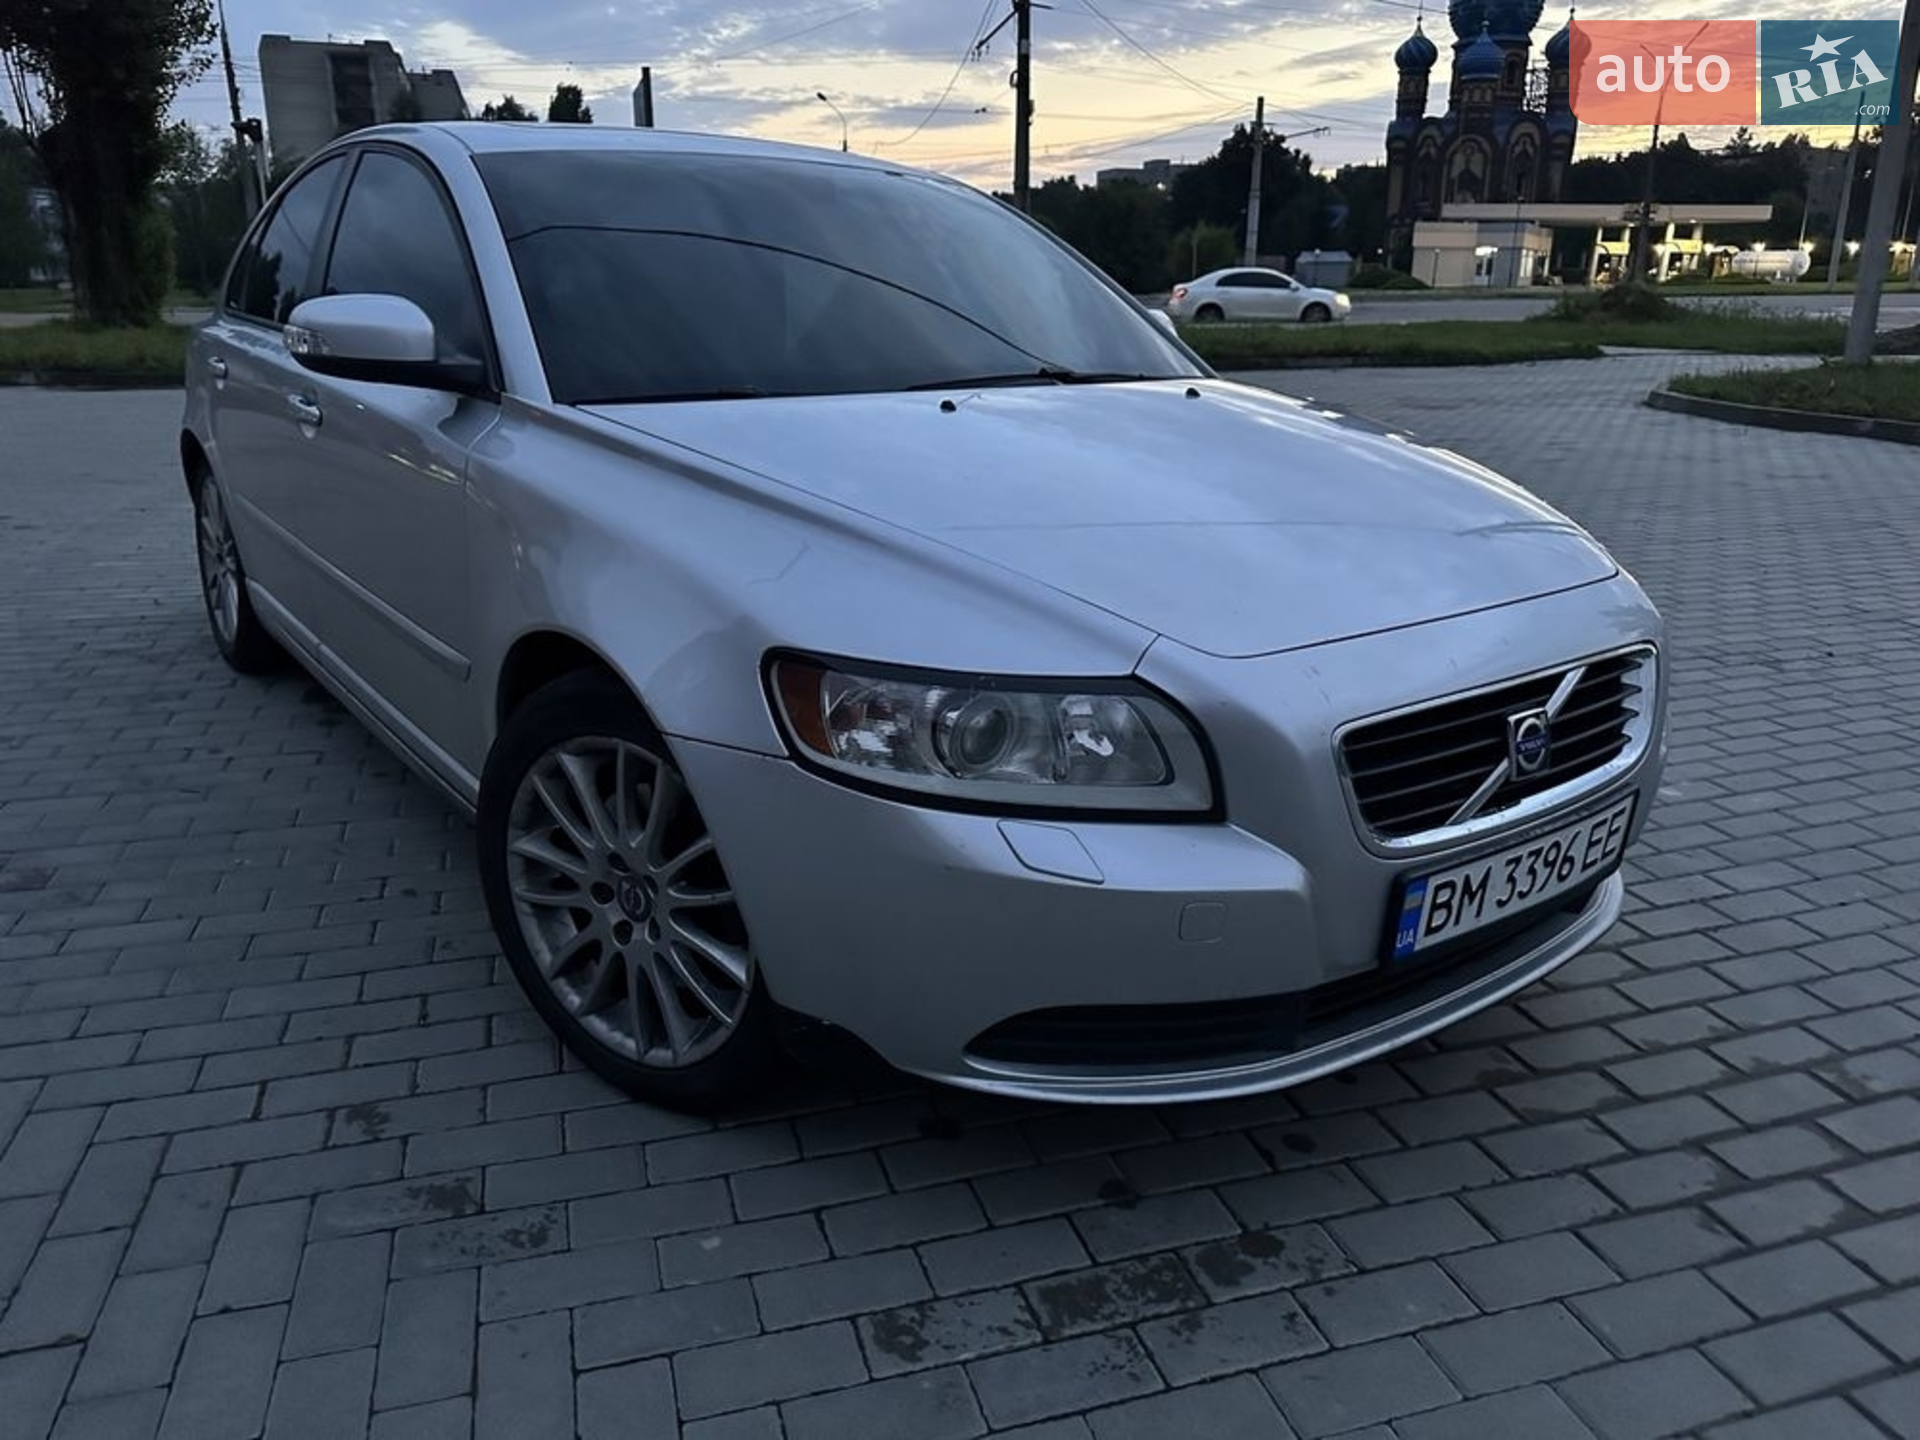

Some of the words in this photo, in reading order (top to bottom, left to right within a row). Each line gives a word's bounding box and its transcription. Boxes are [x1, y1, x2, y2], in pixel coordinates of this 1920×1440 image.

[1423, 865, 1492, 938] BM
[1495, 829, 1582, 909] 3396
[1580, 806, 1627, 873] EE
[1396, 928, 1414, 948] UA
